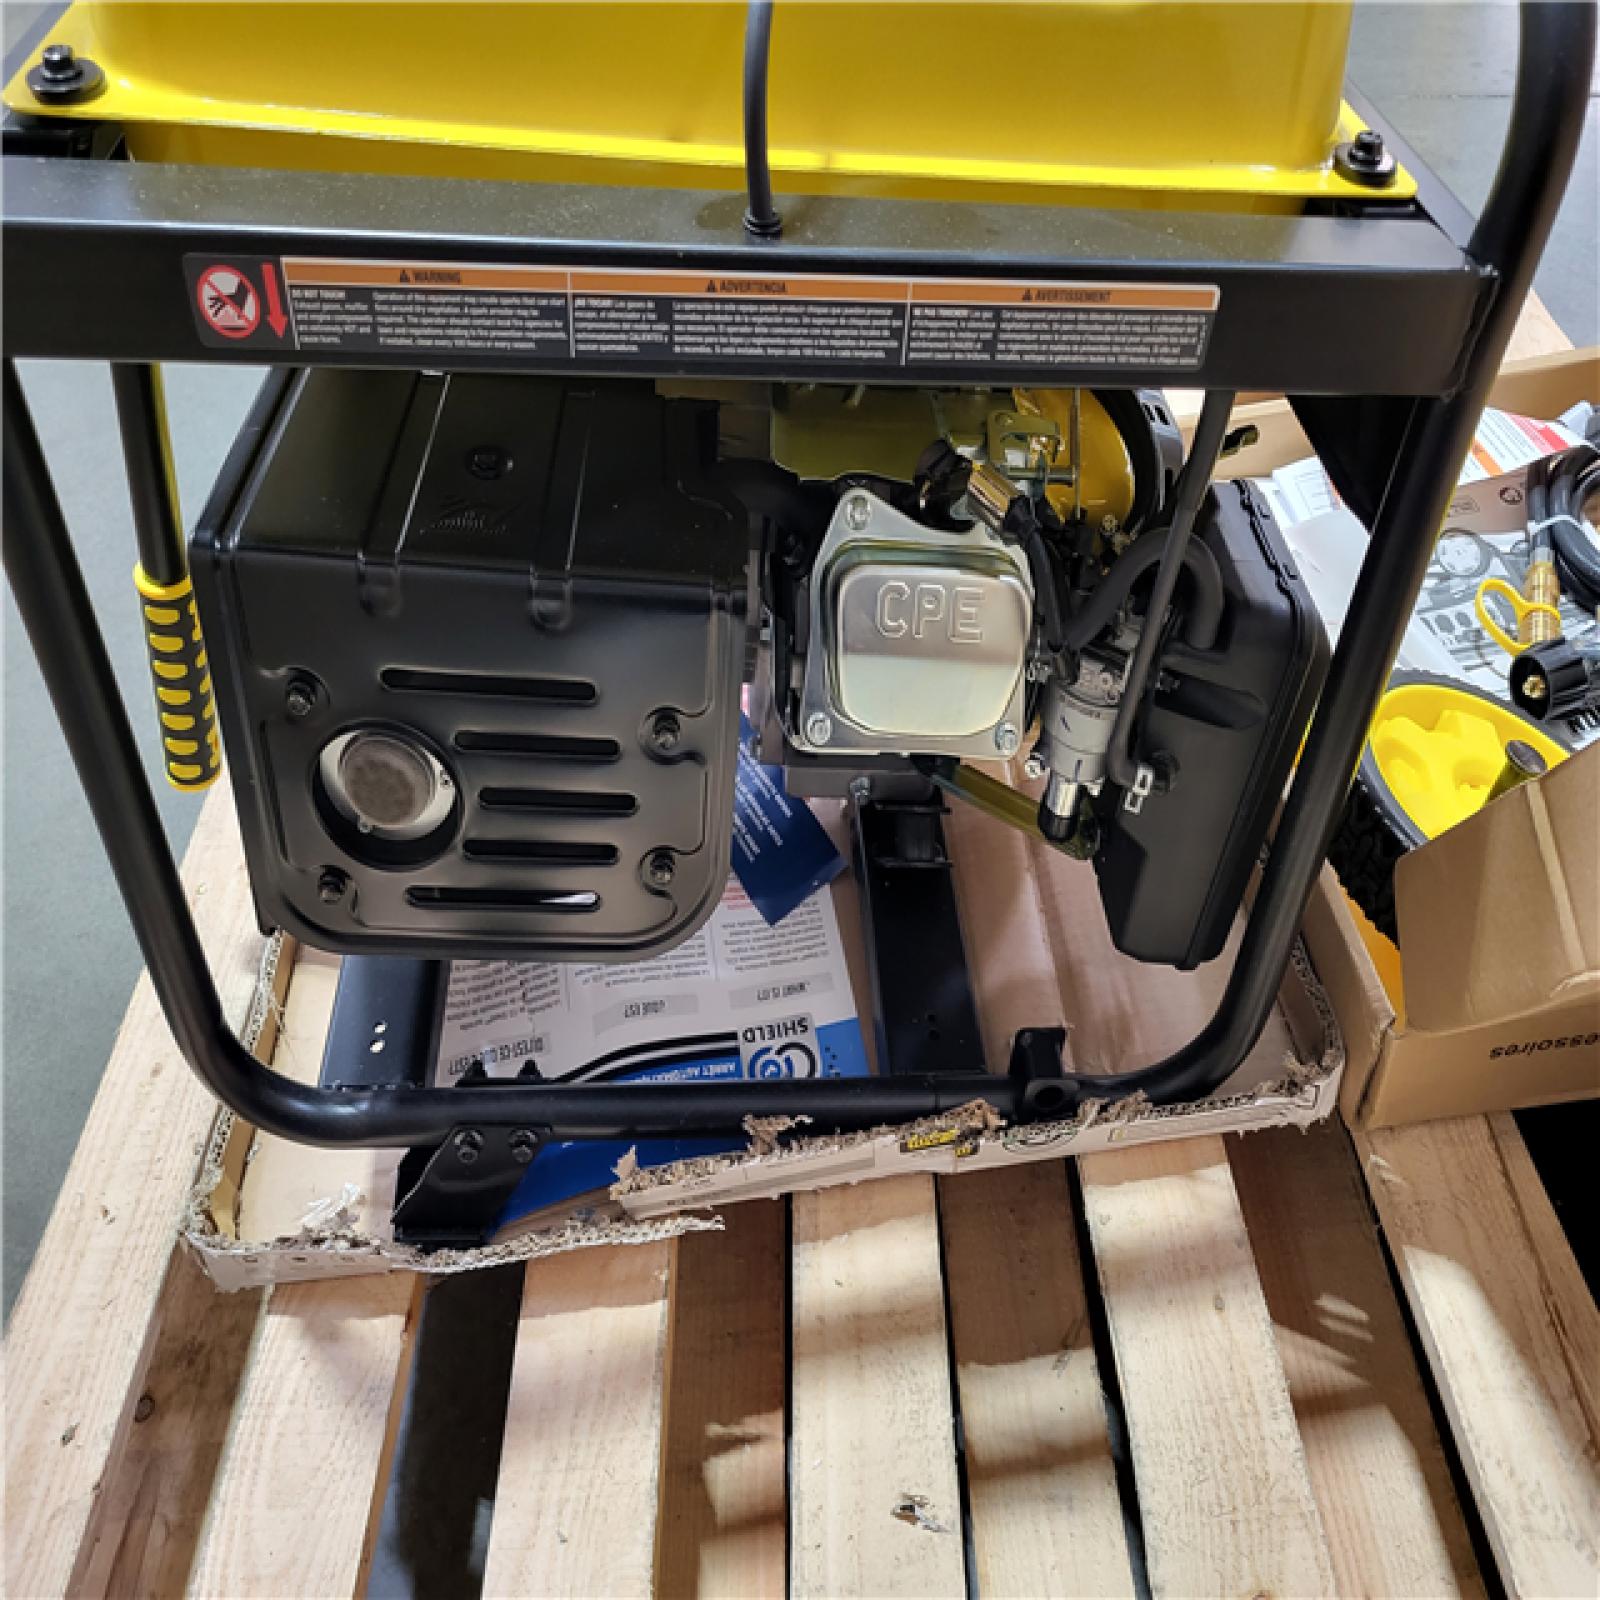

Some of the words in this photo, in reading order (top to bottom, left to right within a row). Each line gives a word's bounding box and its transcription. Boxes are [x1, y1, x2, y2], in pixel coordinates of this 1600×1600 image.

[414, 271, 461, 284] WARNING
[719, 279, 787, 293] ADVERTENCIA
[1035, 288, 1111, 303] AVERTISSEMENT
[876, 579, 986, 643] CPE
[742, 1016, 809, 1044] SHIELD
